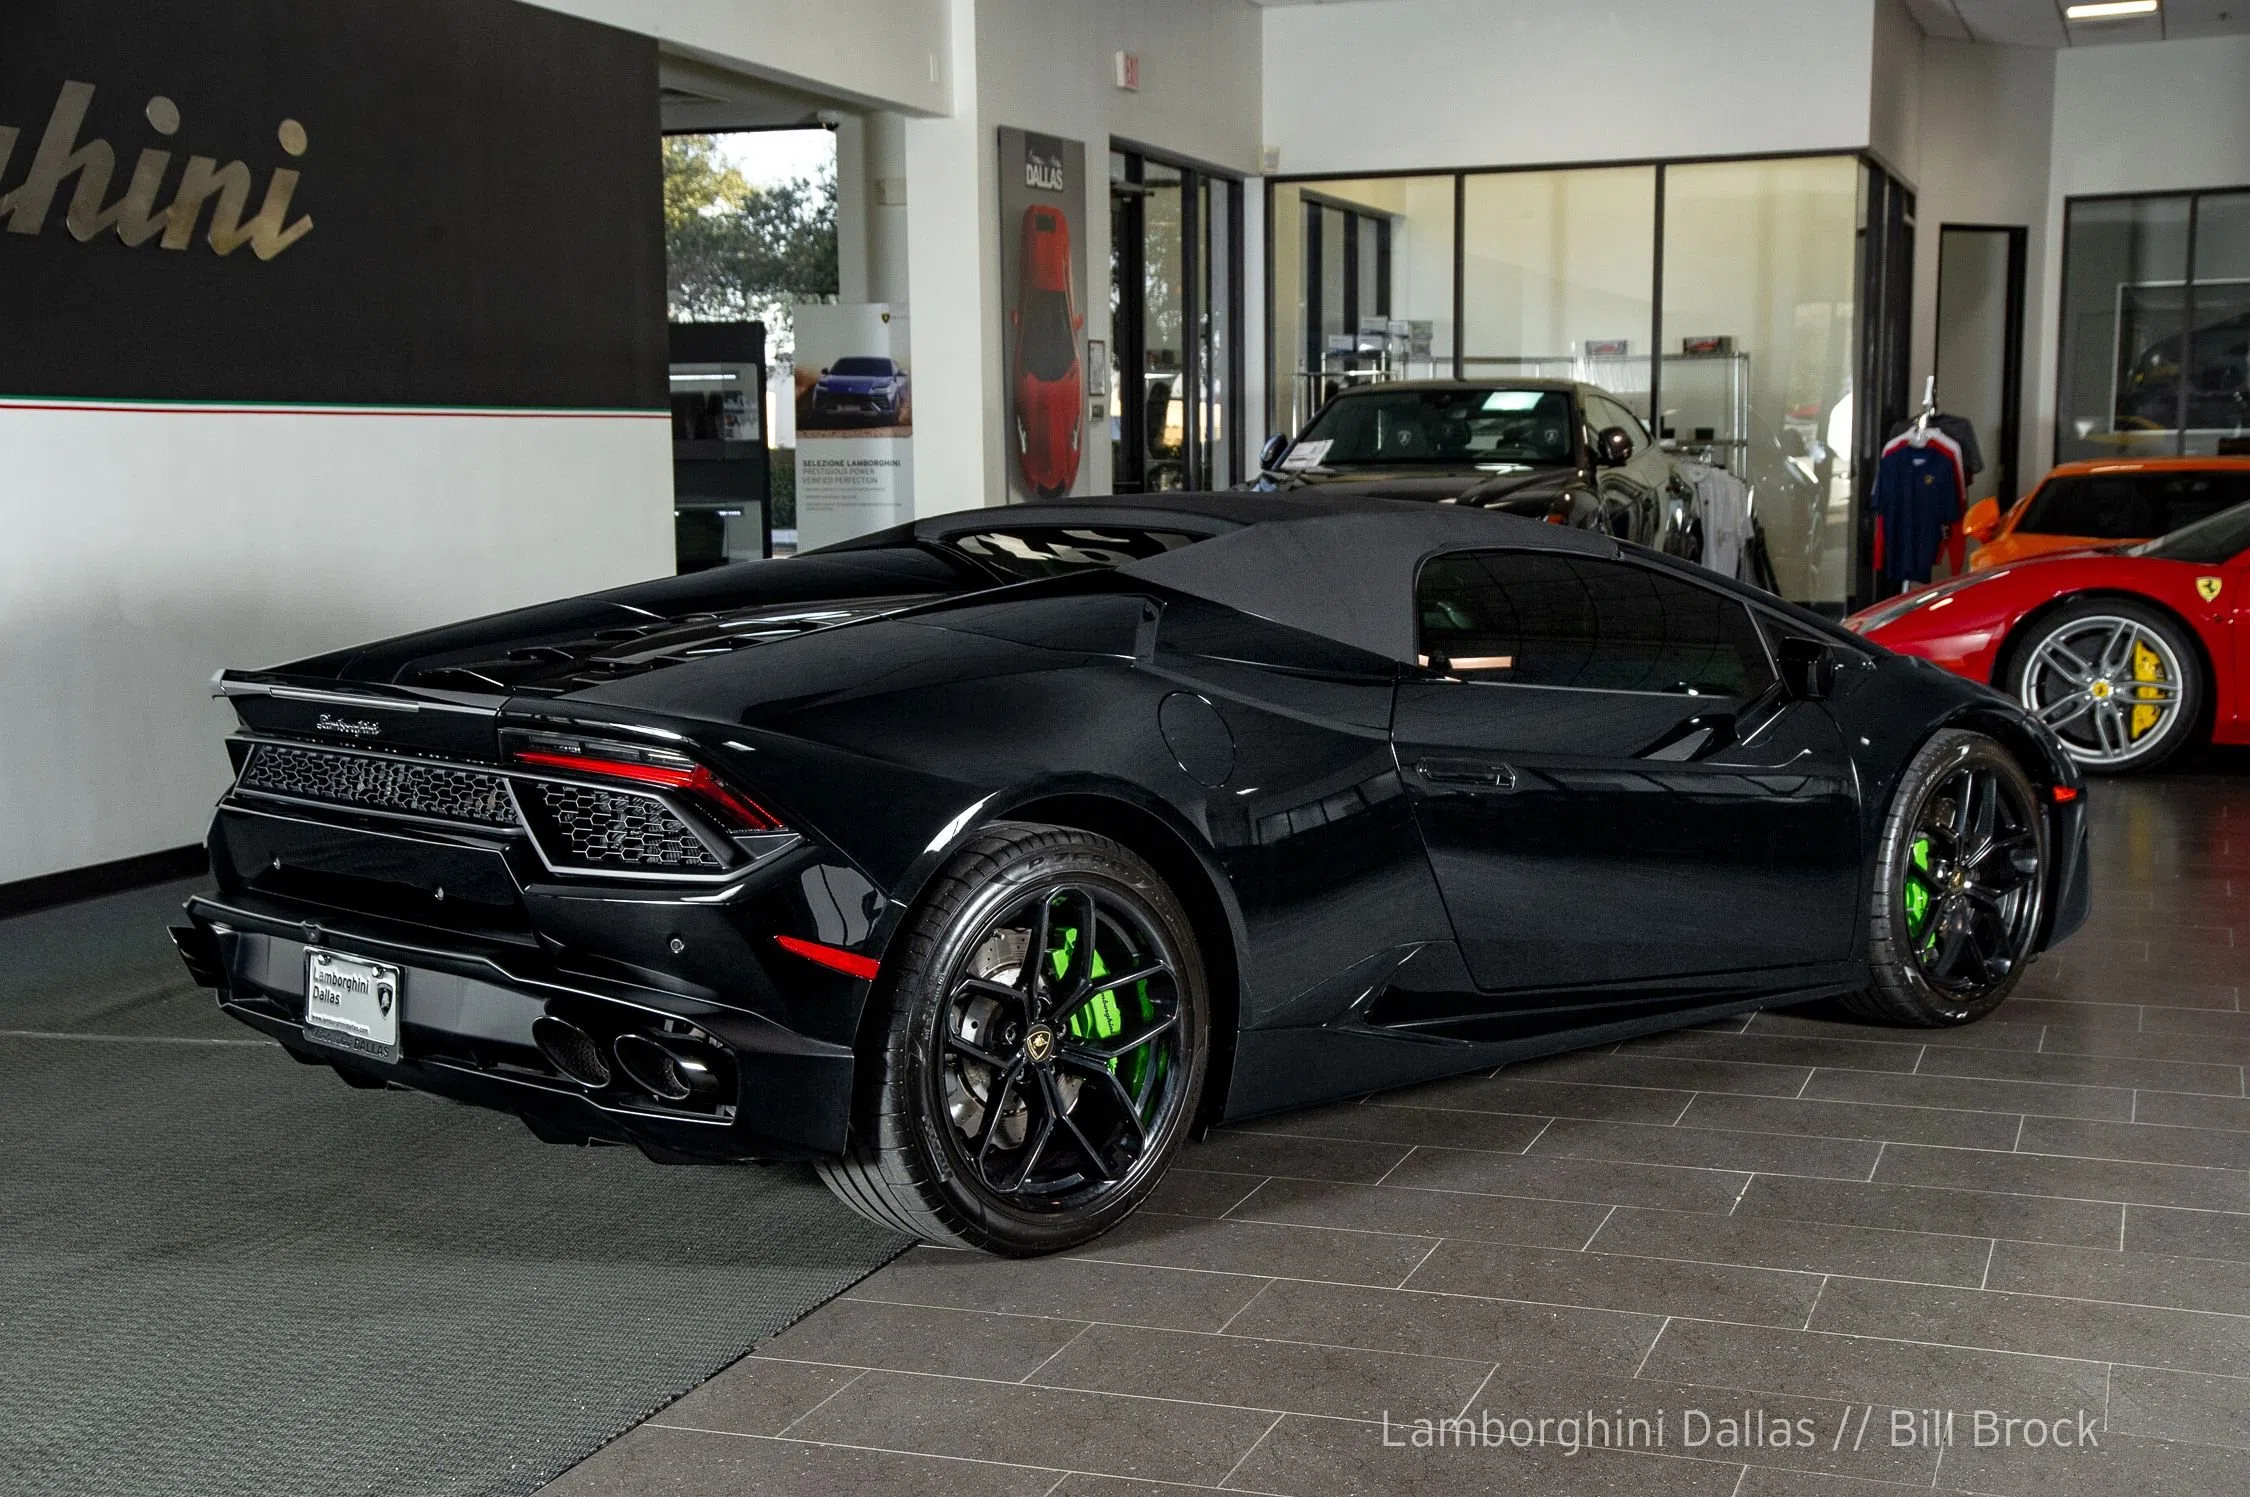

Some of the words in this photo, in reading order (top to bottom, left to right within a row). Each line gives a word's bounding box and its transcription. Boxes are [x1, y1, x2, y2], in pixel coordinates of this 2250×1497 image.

[1026, 163, 1063, 190] DALLAS
[802, 459, 845, 467] SELEZIONE
[847, 459, 901, 467] LAMBORGHINI
[802, 476, 833, 484] VERIFIED
[835, 476, 878, 484] PERFECTION
[313, 966, 370, 995] Lamborghini
[313, 985, 341, 1005] Dallas
[353, 1038, 390, 1058] DALLAS
